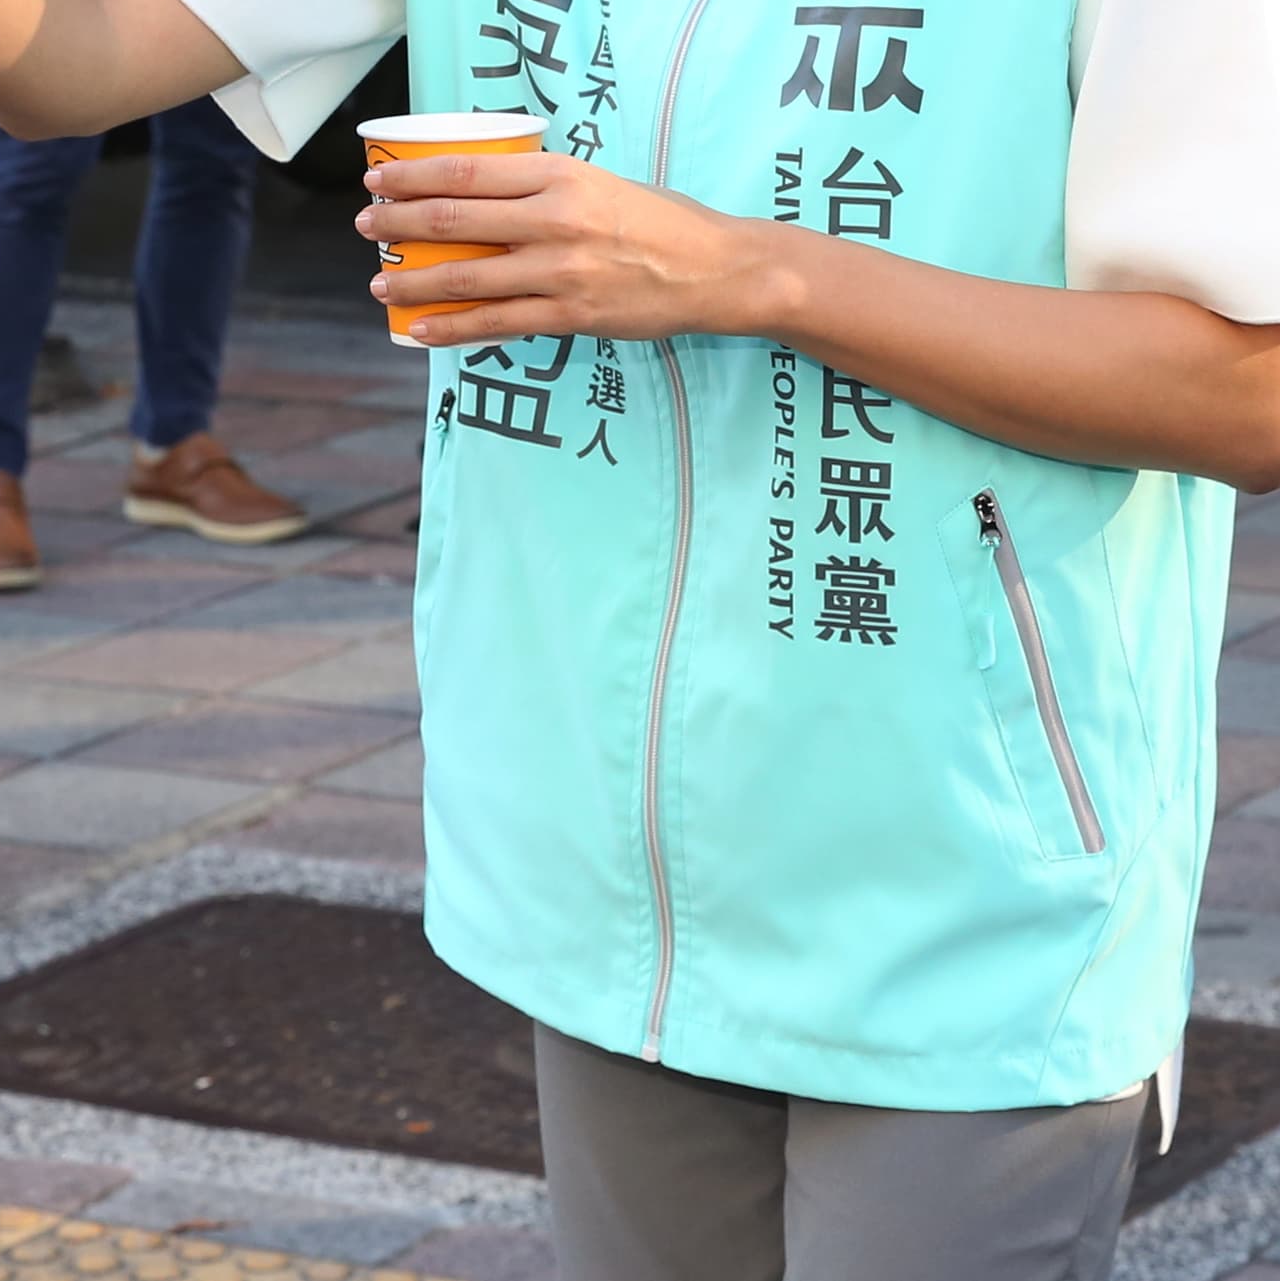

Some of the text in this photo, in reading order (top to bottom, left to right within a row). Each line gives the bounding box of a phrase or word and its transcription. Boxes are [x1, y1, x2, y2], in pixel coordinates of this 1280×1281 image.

[770, 342, 796, 499] EOPLE'S
[814, 146, 904, 646] 台民眾黨
[768, 517, 794, 640] PARTY
